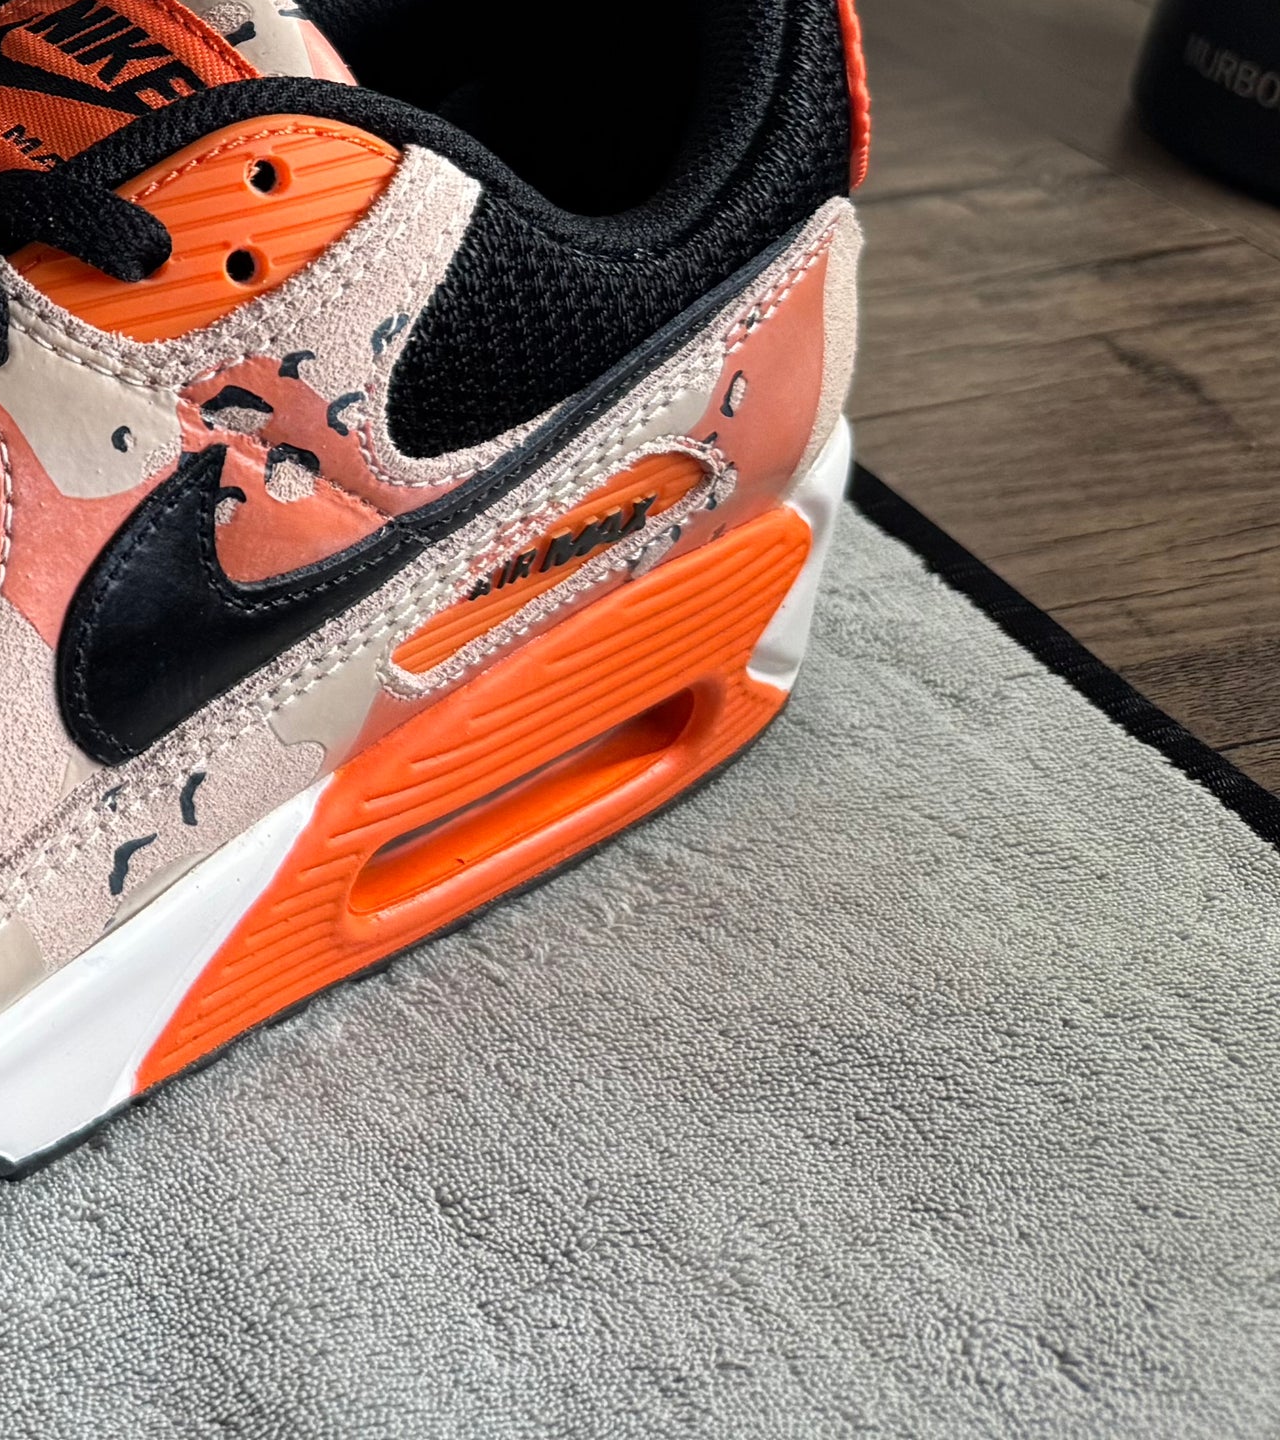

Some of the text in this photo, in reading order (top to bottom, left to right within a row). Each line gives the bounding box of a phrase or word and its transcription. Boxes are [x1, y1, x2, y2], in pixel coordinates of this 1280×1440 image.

[1, 124, 64, 172] MA
[468, 494, 658, 602] AIR MAX
